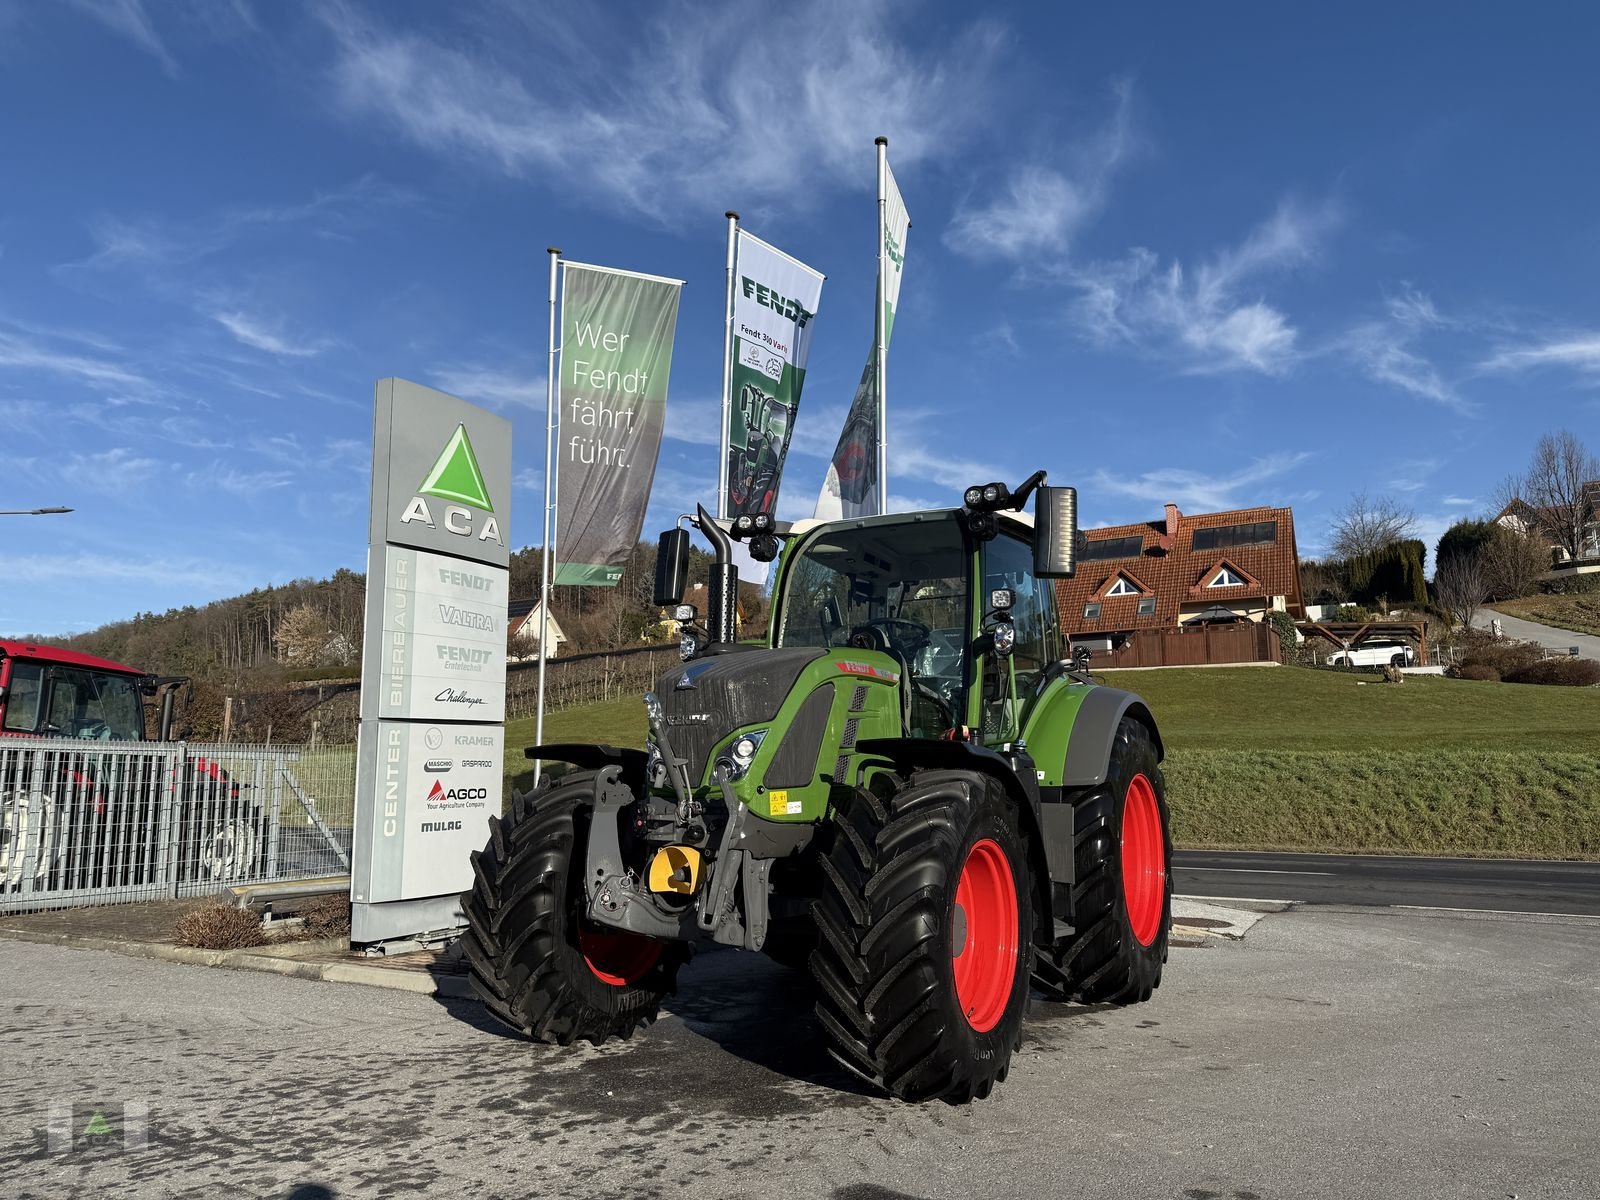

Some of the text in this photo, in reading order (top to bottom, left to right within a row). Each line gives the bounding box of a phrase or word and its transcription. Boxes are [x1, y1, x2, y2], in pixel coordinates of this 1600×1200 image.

[742, 275, 814, 329] FENDT
[575, 321, 630, 352] Wer
[741, 324, 761, 340] Fendt
[573, 360, 648, 394] Fendt
[571, 397, 634, 434] fährt,
[569, 436, 631, 468] führt.
[400, 496, 504, 547] ACA
[438, 568, 494, 592] FENDT
[390, 559, 408, 706] BIERBAUER
[438, 604, 494, 632] VALTRA
[436, 644, 492, 664] FENDT
[434, 687, 488, 708] Challenger
[455, 735, 494, 747] KRAMER
[383, 729, 400, 837] CENTER
[446, 788, 487, 800] AGCO
[439, 802, 465, 810] Agriculture
